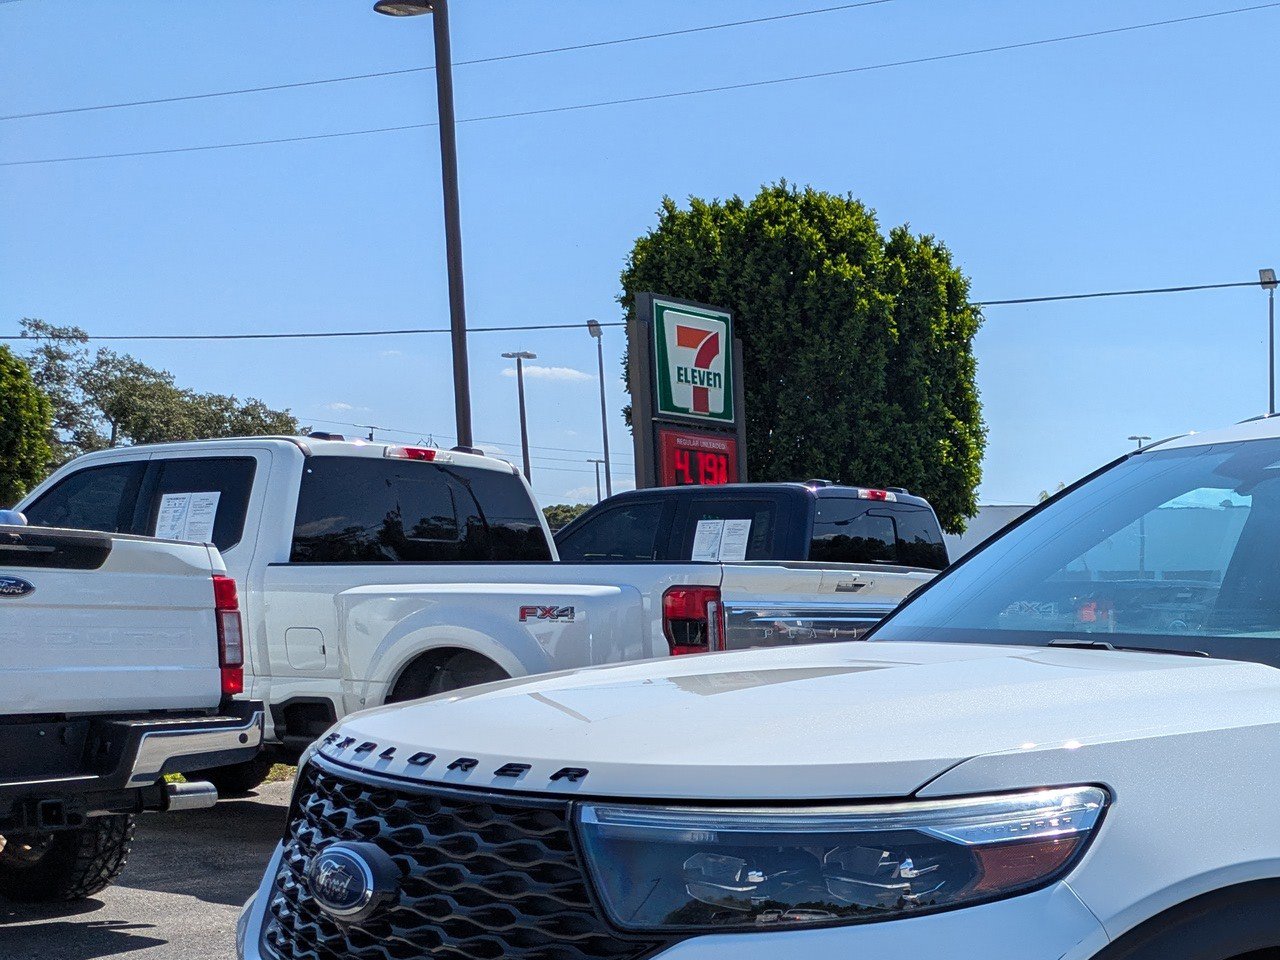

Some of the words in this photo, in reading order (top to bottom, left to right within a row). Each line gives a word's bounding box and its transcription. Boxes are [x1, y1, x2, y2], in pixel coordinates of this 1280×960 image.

[677, 325, 720, 413] 7
[519, 605, 575, 622] FX4
[323, 731, 590, 782] EXPLORER
[317, 859, 354, 902] Ford
